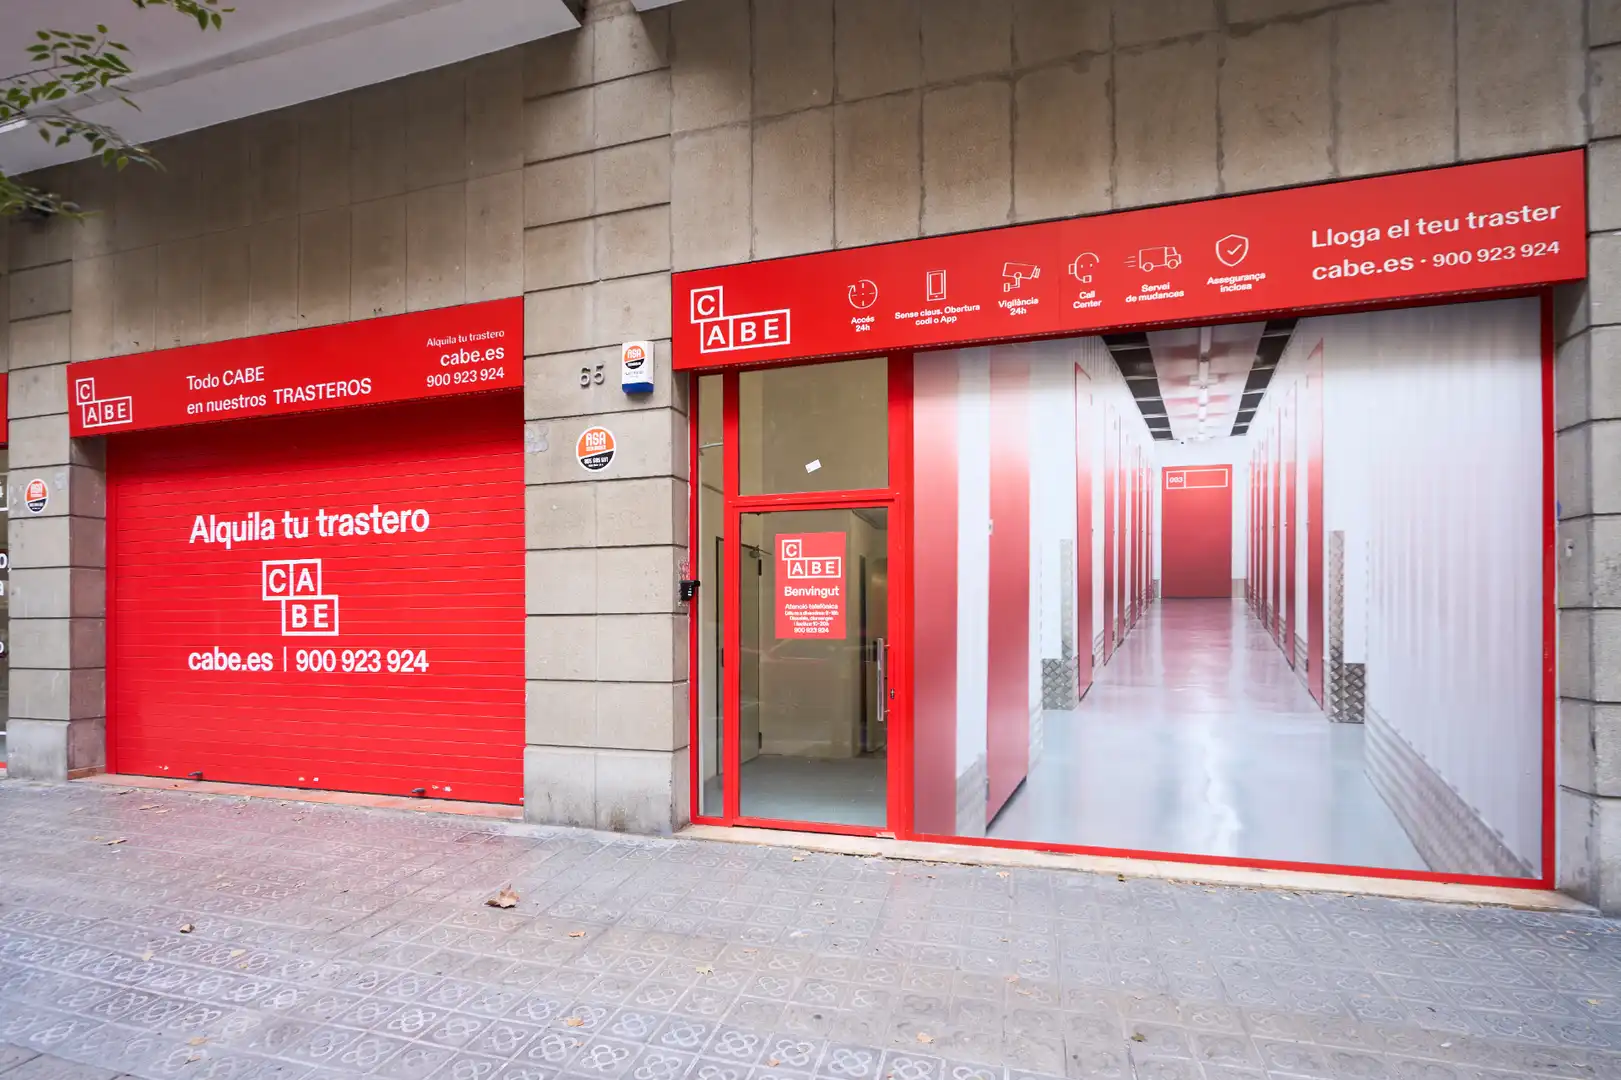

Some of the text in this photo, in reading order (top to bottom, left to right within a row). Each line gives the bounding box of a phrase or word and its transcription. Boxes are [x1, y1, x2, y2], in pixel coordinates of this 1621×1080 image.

[1311, 204, 1561, 248] Lloga el teu traster
[1312, 240, 1560, 280] cabe.es 900 923 924
[1207, 272, 1266, 286] Assegurança
[1079, 291, 1096, 300] Call
[1141, 282, 1170, 293] Servei
[1220, 283, 1253, 293] inclosa
[1125, 289, 1184, 303] de mudances
[894, 311, 919, 320] Sense
[944, 304, 980, 315] Obertura
[1010, 307, 1026, 316] 24h
[1073, 300, 1102, 309] Center
[915, 317, 932, 326] codi
[940, 314, 957, 325] App
[426, 330, 504, 348] Alquila tu trastero
[440, 347, 504, 366] cabe.es
[186, 366, 265, 390] Todo CABE
[427, 367, 504, 387] 900 923 924
[580, 364, 605, 387] 65
[187, 377, 372, 415] en nuestros TRASTEROS
[586, 431, 606, 447] ASA
[189, 504, 430, 550] Alquila tu trastero
[784, 586, 840, 598] Benvingut
[188, 646, 430, 672] cabe.es 900 923 924
